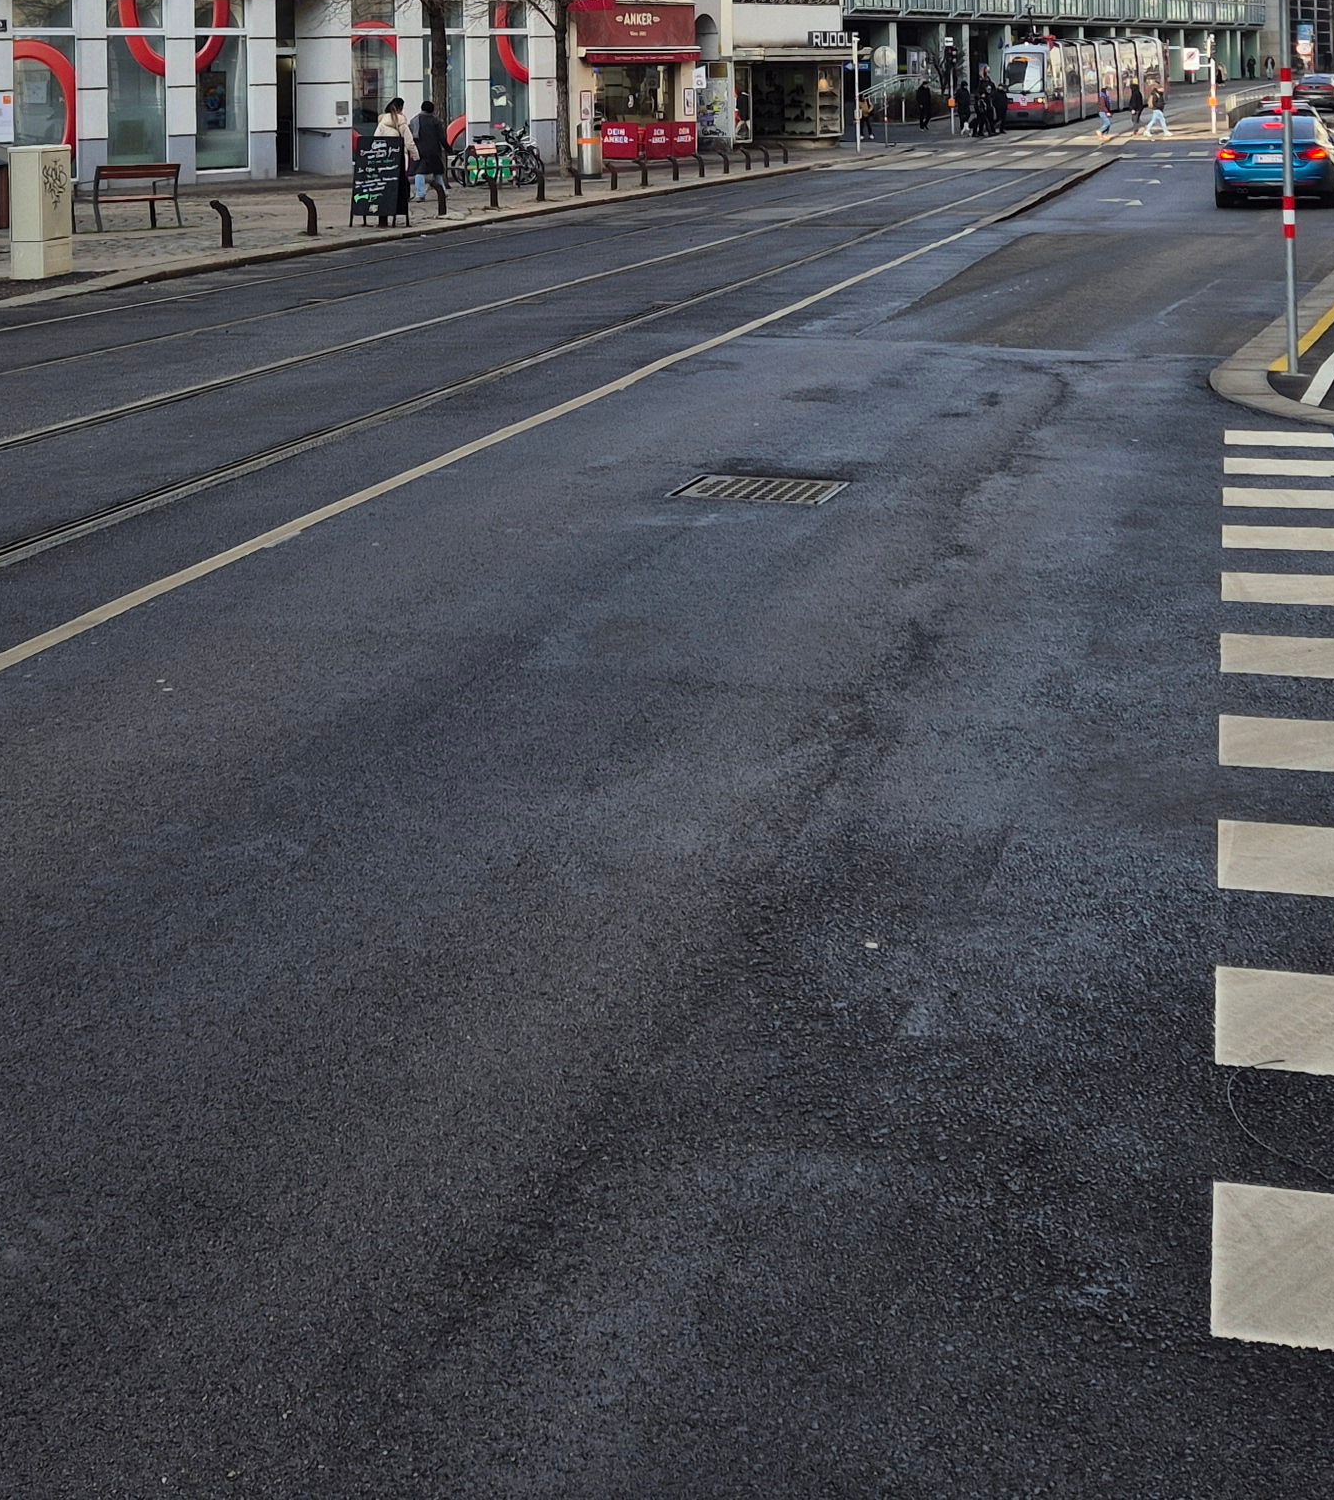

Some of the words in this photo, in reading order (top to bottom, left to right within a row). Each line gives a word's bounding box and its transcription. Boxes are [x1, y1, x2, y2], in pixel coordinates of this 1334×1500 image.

[623, 12, 653, 26] ANKER
[812, 31, 860, 47] RUDOLF
[607, 127, 626, 136] DEIN
[603, 135, 629, 144] ANKER
